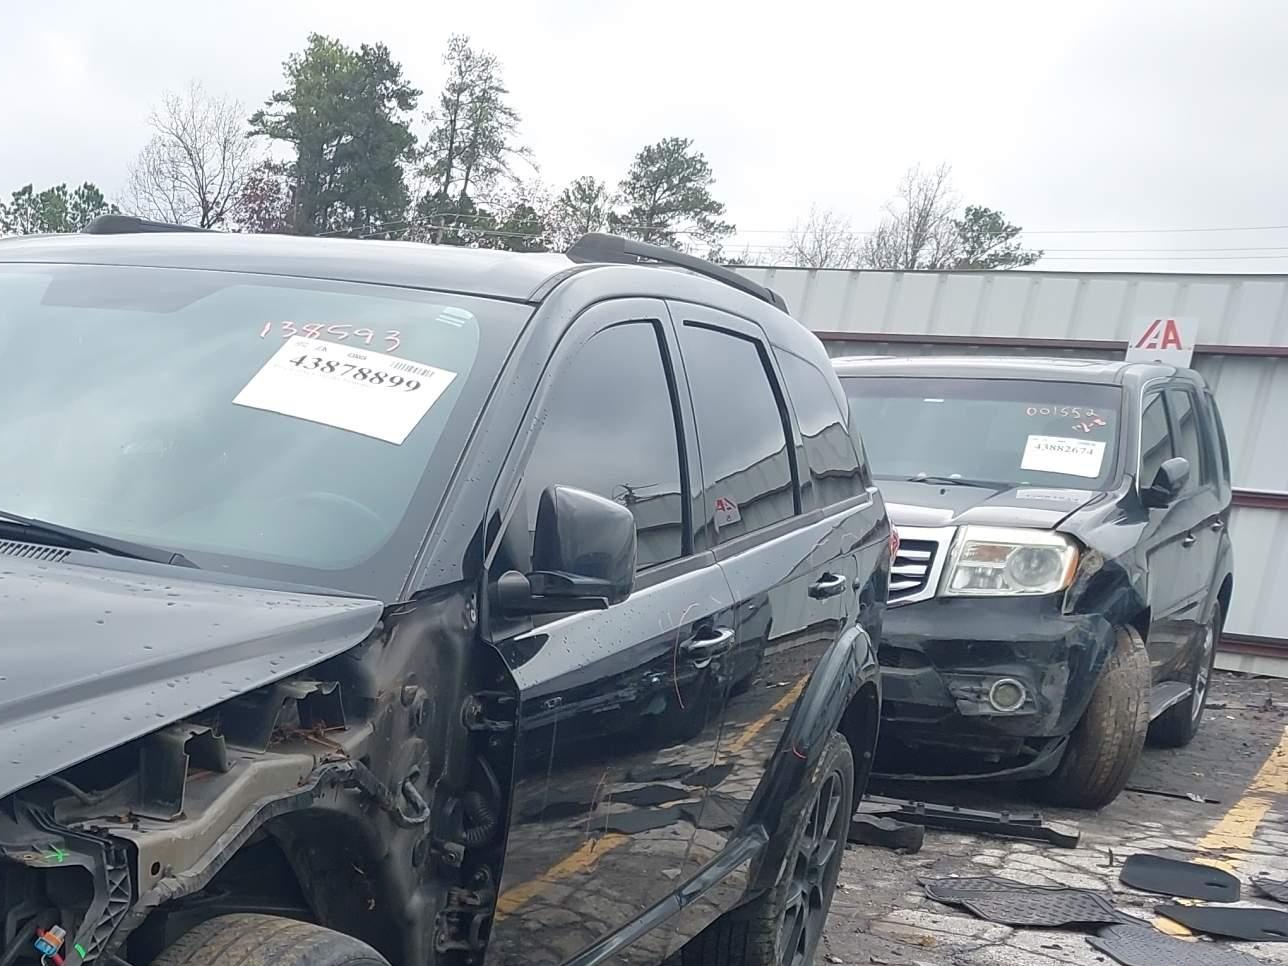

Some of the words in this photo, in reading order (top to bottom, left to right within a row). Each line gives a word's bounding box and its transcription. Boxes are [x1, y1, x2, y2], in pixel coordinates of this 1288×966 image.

[259, 321, 402, 352] 138593
[289, 354, 422, 393] 43878899
[1033, 443, 1094, 456] 43882674
